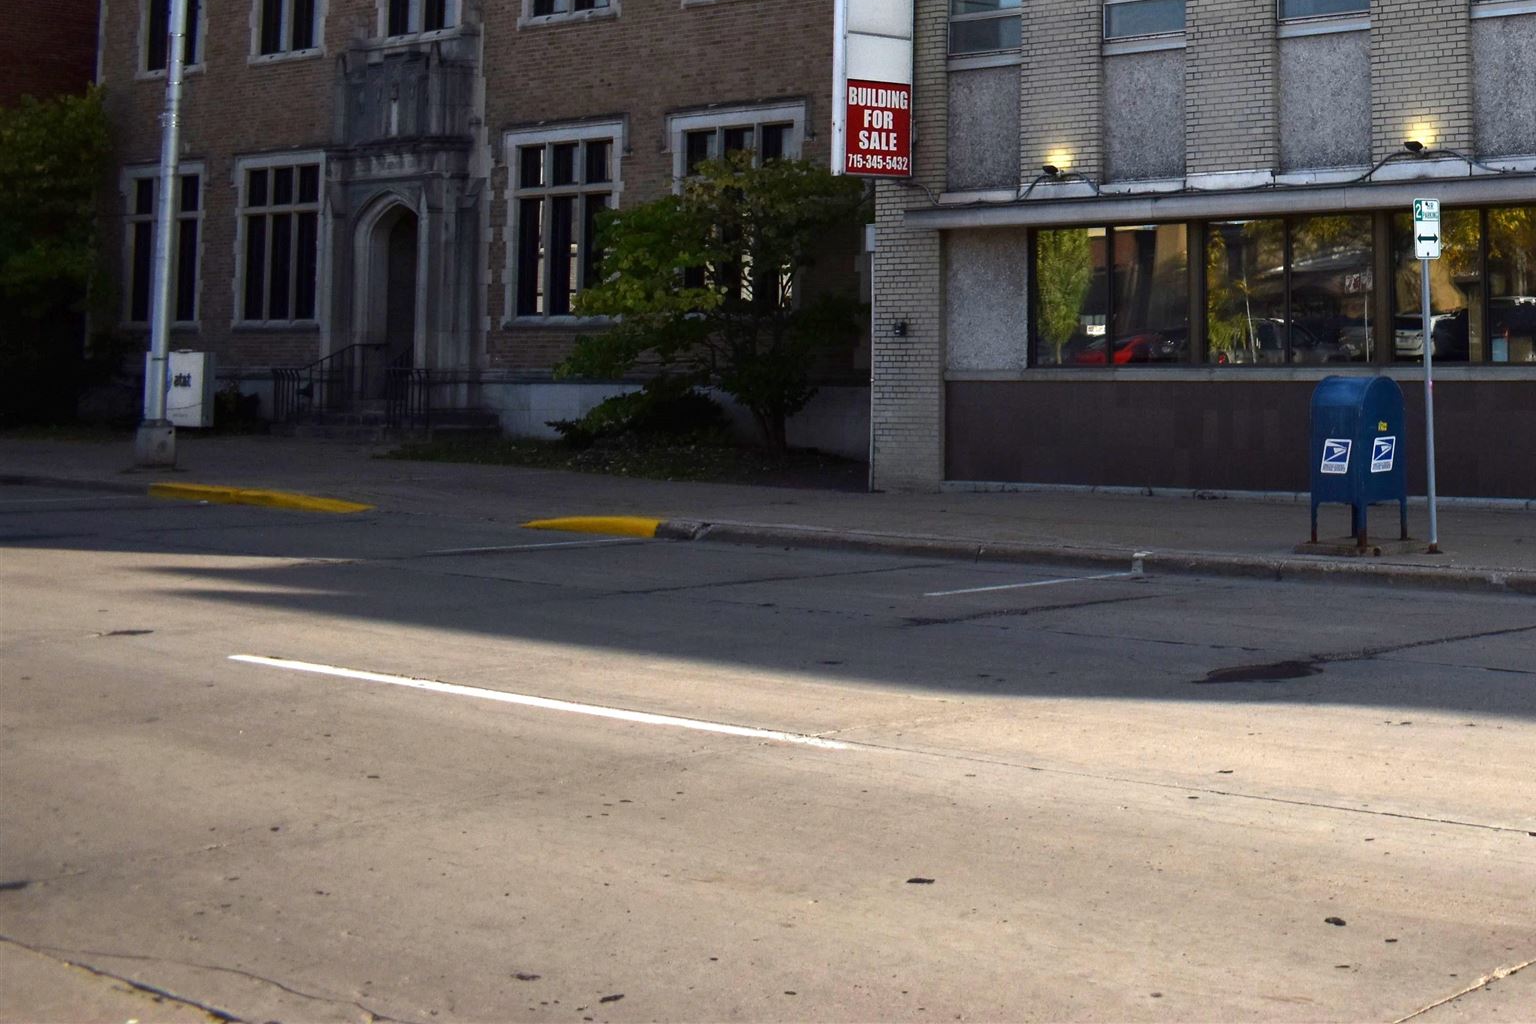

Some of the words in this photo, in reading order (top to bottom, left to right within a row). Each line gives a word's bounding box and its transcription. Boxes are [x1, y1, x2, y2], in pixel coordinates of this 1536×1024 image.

[848, 86, 908, 110] BUILDING
[863, 109, 894, 130] FOR
[858, 130, 898, 151] SALE
[848, 153, 908, 171] 715-345-5432
[1415, 203, 1422, 219] 2
